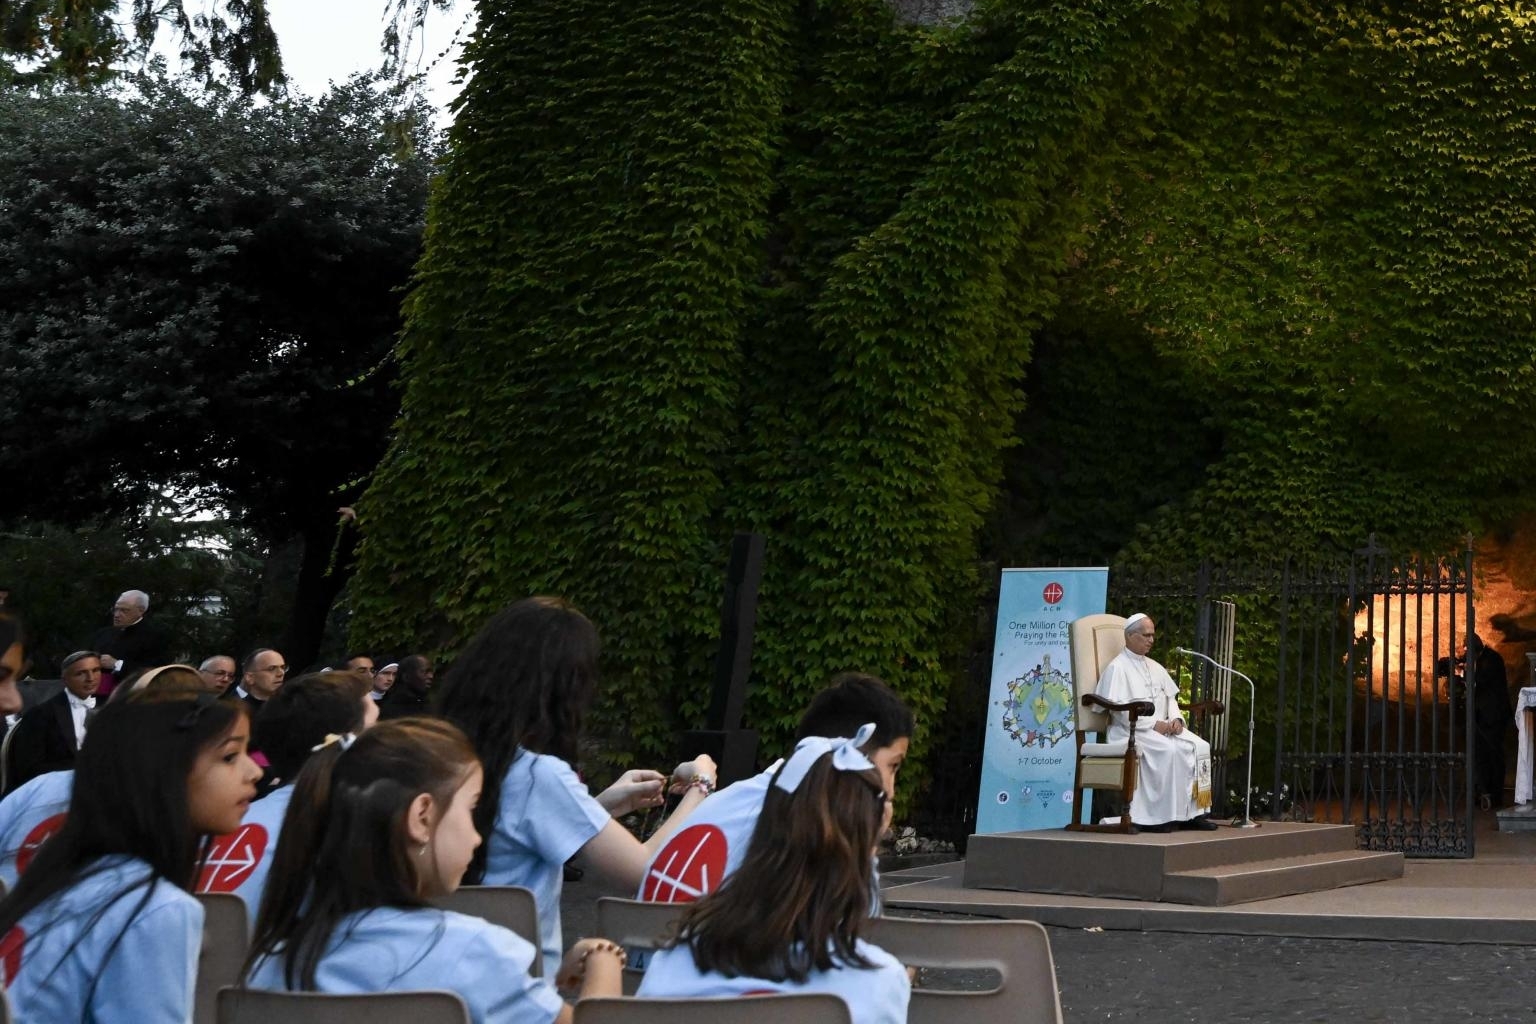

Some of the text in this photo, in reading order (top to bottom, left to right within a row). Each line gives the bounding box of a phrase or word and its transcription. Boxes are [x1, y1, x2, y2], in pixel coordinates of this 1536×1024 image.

[1008, 621, 1027, 630] One
[1029, 620, 1056, 630] Million
[1014, 631, 1044, 641] Praying
[1018, 757, 1062, 766] 1-7 October
